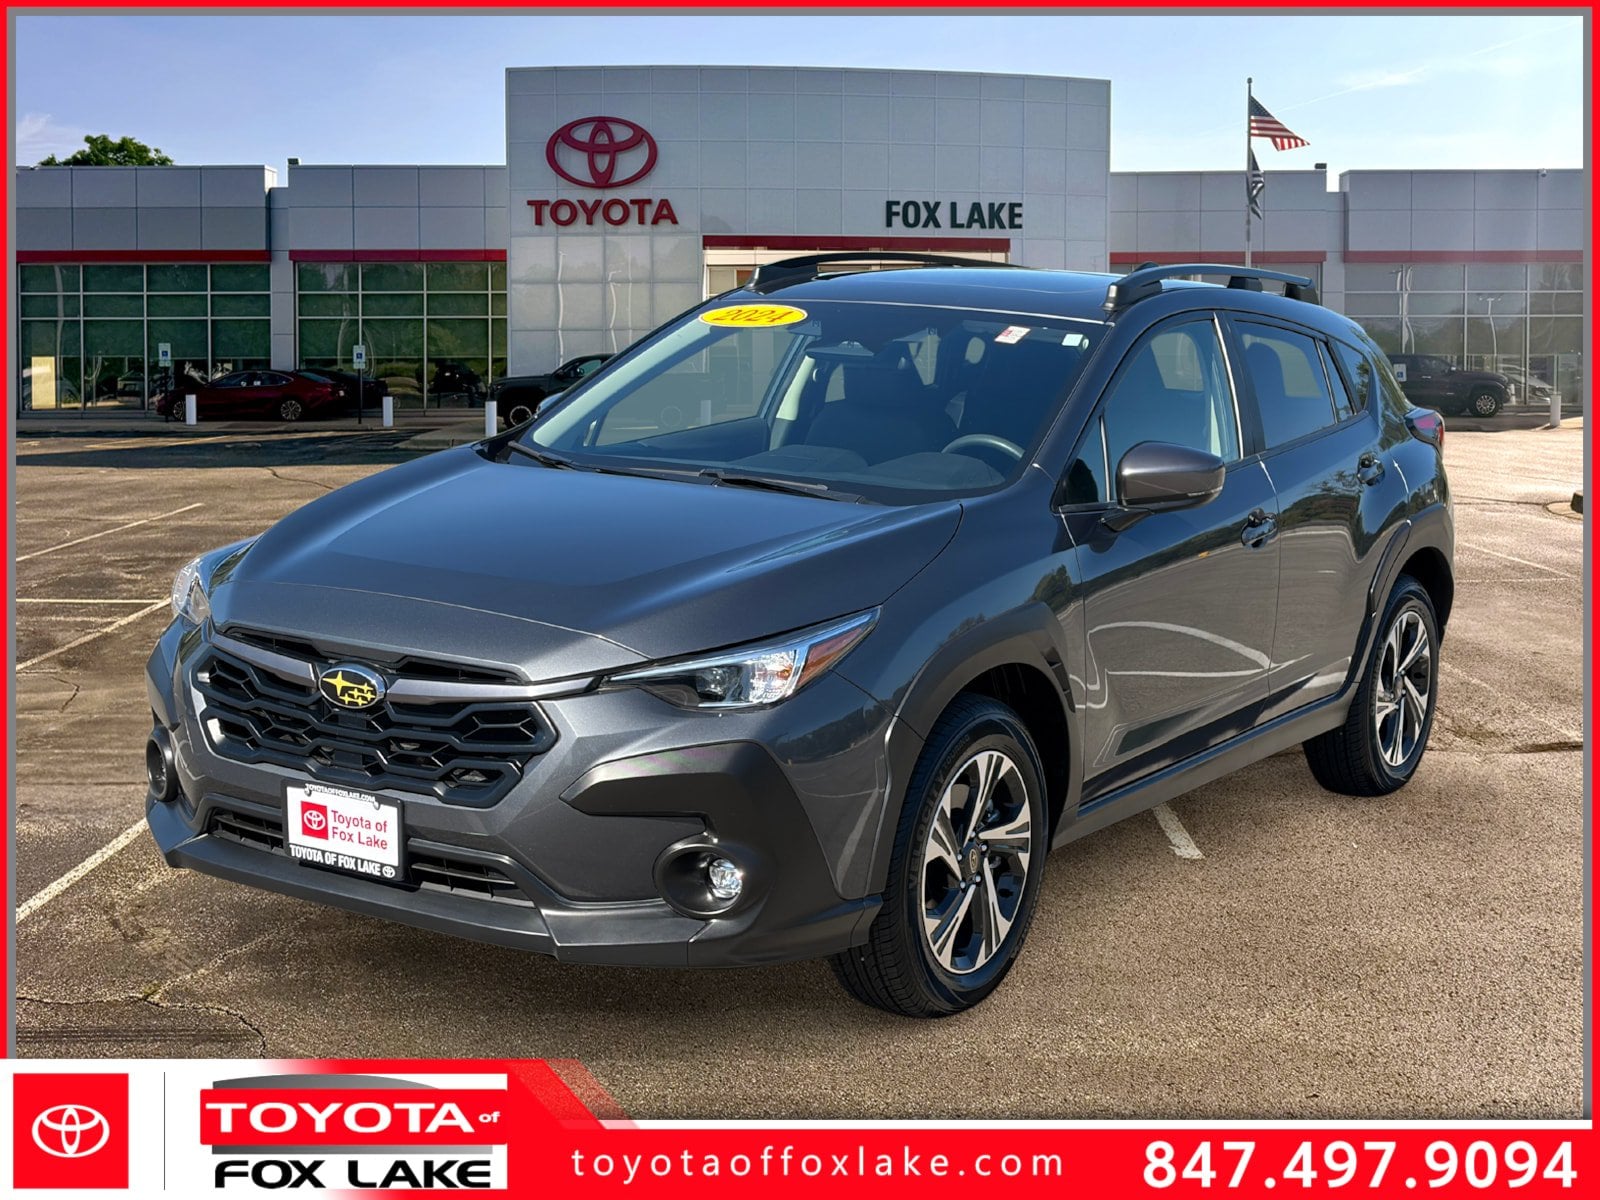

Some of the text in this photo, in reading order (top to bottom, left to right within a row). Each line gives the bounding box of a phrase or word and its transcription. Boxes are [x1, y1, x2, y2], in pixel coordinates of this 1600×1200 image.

[527, 198, 679, 226] TOYOTA
[885, 200, 1024, 230] FOX LAKE
[712, 308, 794, 323] 2024
[331, 809, 388, 833] Toyota of
[331, 826, 388, 850] Fox Lake
[289, 844, 382, 877] TOYOTA OF FOX LAKE
